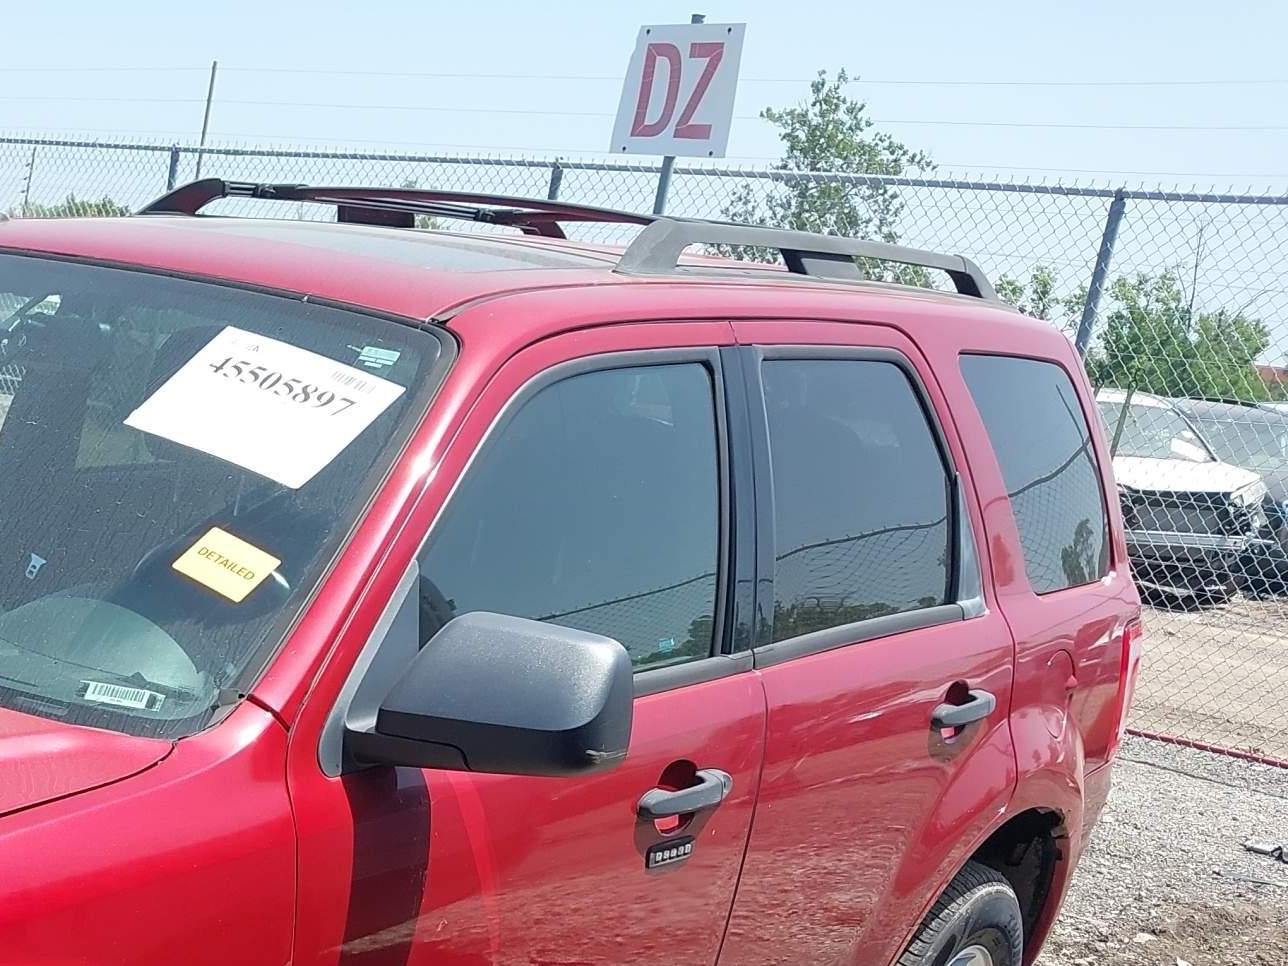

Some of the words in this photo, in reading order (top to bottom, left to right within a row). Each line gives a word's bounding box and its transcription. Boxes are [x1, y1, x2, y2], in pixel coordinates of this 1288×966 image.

[630, 42, 725, 140] DZ
[209, 356, 356, 416] 45505897
[197, 546, 256, 581] DETAILED
